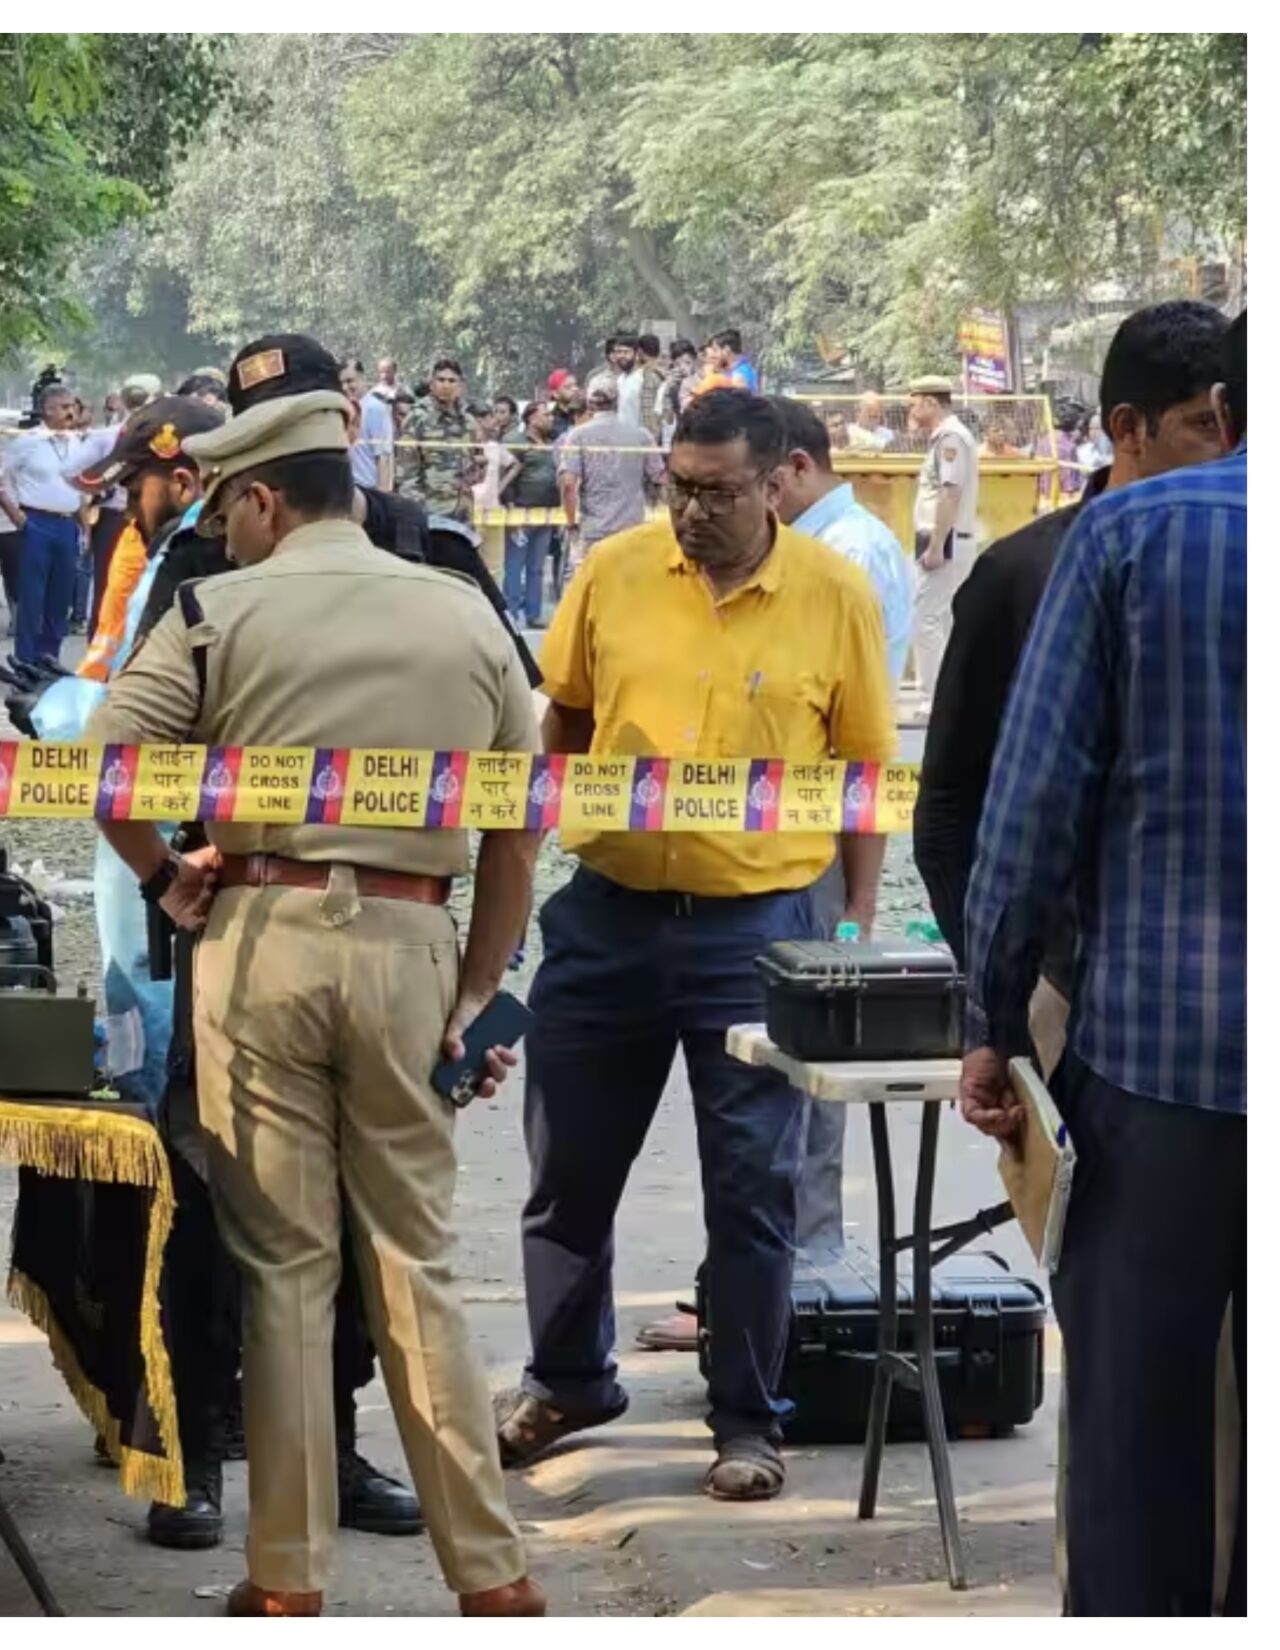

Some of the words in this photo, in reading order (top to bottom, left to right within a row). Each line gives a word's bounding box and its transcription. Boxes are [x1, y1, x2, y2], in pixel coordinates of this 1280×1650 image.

[32, 747, 89, 770] DELHI
[149, 745, 197, 767] लाईन
[250, 755, 270, 768] DO
[276, 755, 306, 769] NOT
[364, 755, 419, 778] DELHI
[478, 753, 522, 775] लाईन
[574, 762, 593, 776] DO
[597, 763, 626, 777] NOT
[154, 773, 184, 788] पार
[250, 775, 299, 789] CROSS
[683, 764, 736, 785] DELHI
[886, 769, 906, 782] DO
[21, 782, 90, 805] POLICE
[481, 780, 511, 797] पार
[574, 783, 621, 797] CROSS
[797, 787, 825, 800] पार
[140, 796, 156, 810] न
[258, 796, 292, 810] LINE
[353, 790, 420, 814] POLICE
[582, 802, 615, 817] LINE
[674, 798, 739, 819] POLICE
[470, 805, 483, 820] न
[787, 811, 801, 824] न
